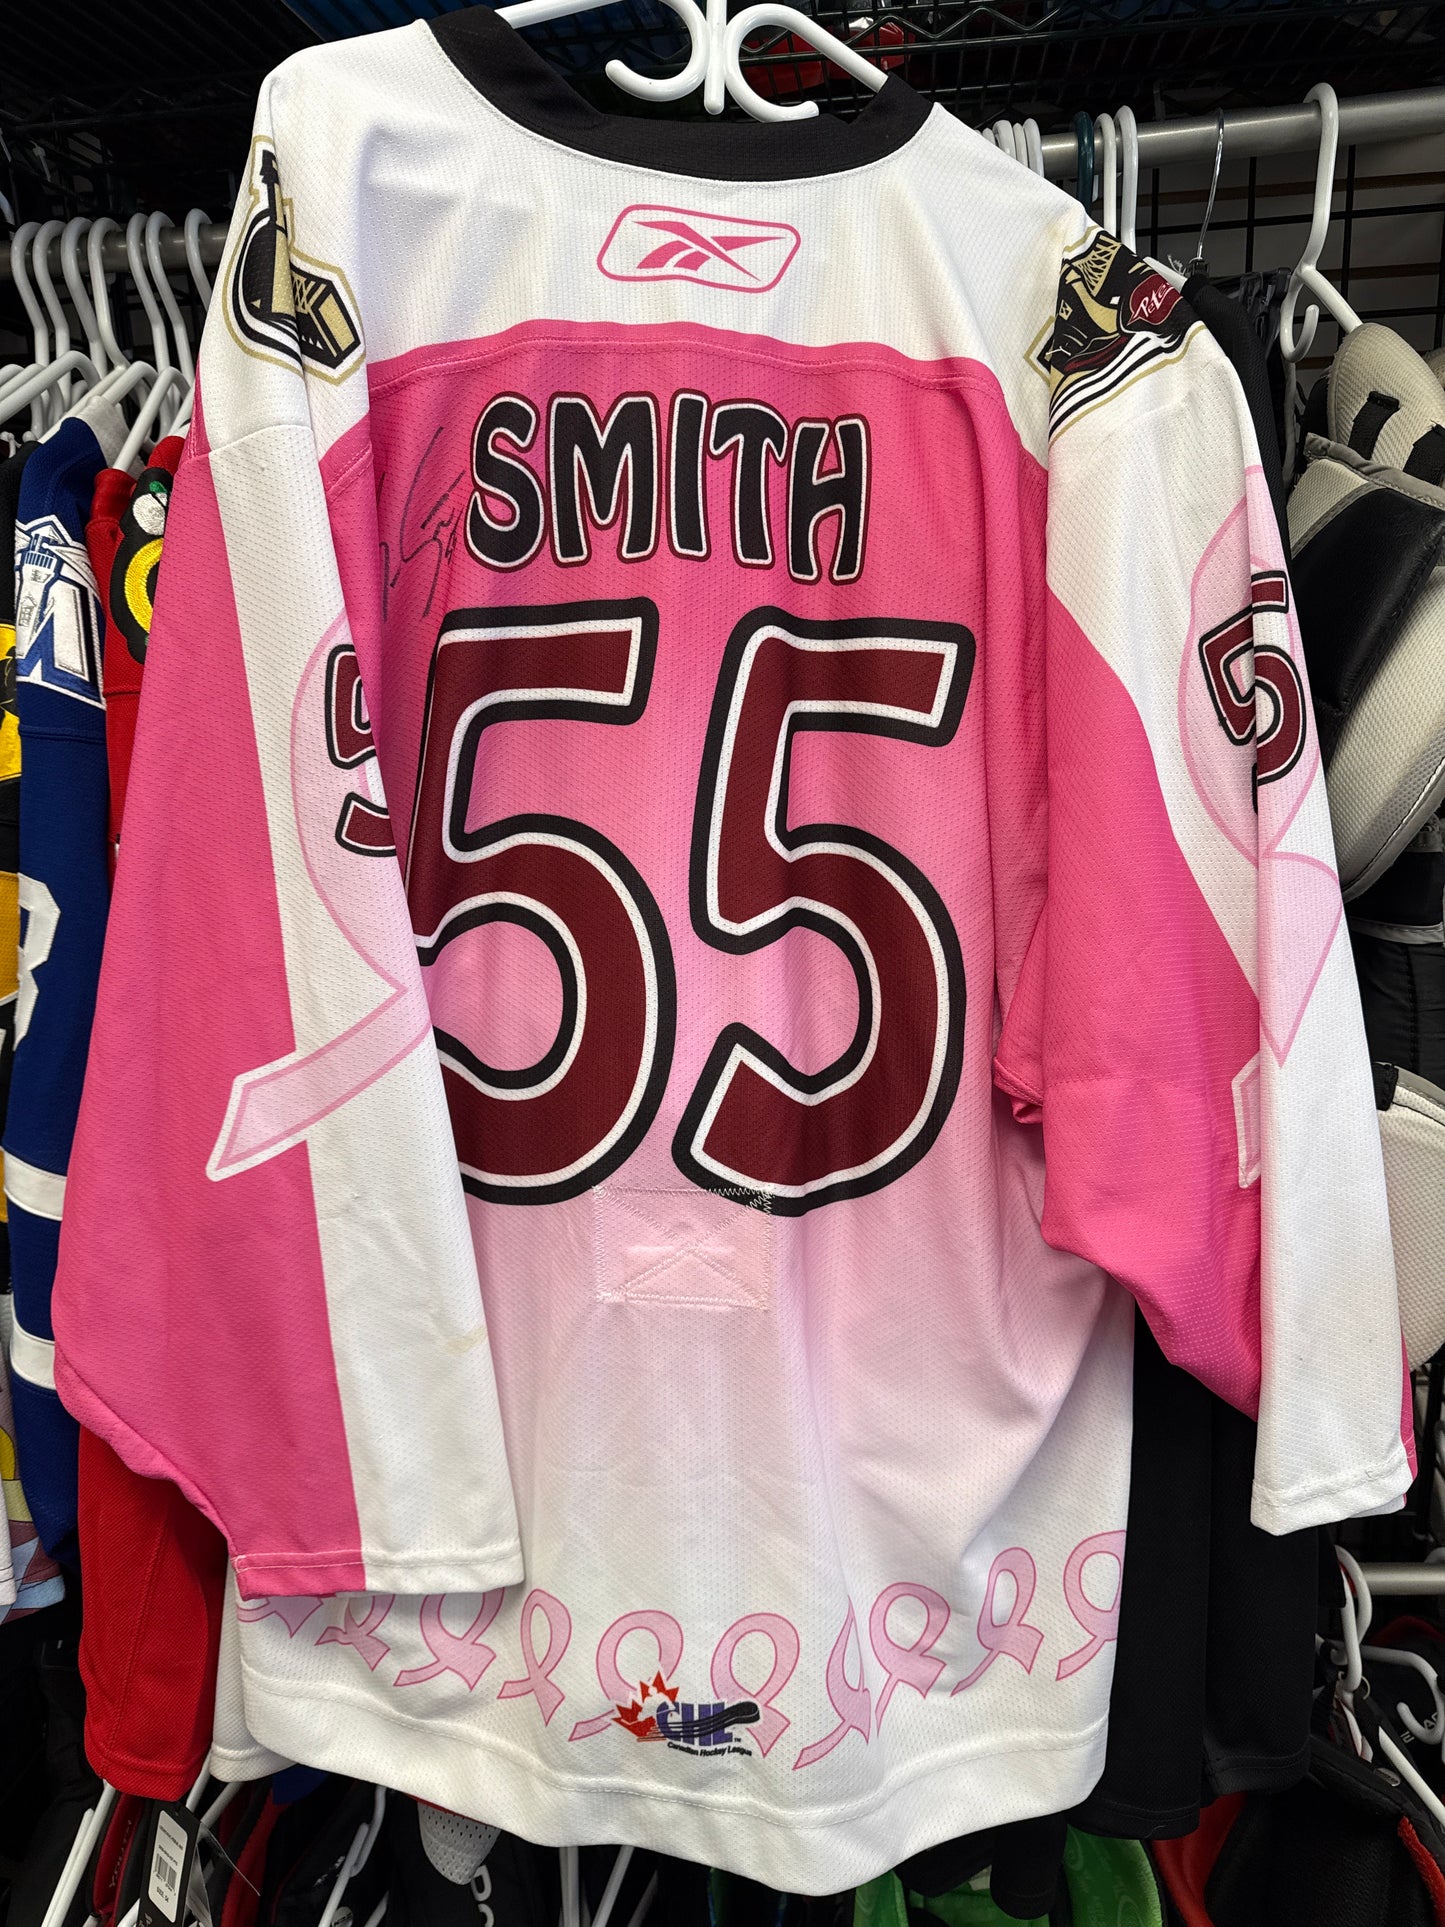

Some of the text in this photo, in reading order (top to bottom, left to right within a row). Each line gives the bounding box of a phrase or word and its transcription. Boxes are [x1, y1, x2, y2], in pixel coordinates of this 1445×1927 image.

[464, 388, 871, 586] SMITH
[407, 597, 976, 1217] 55
[656, 1701, 734, 1746] CHL
[667, 1741, 753, 1757] Canadian Hockey League
